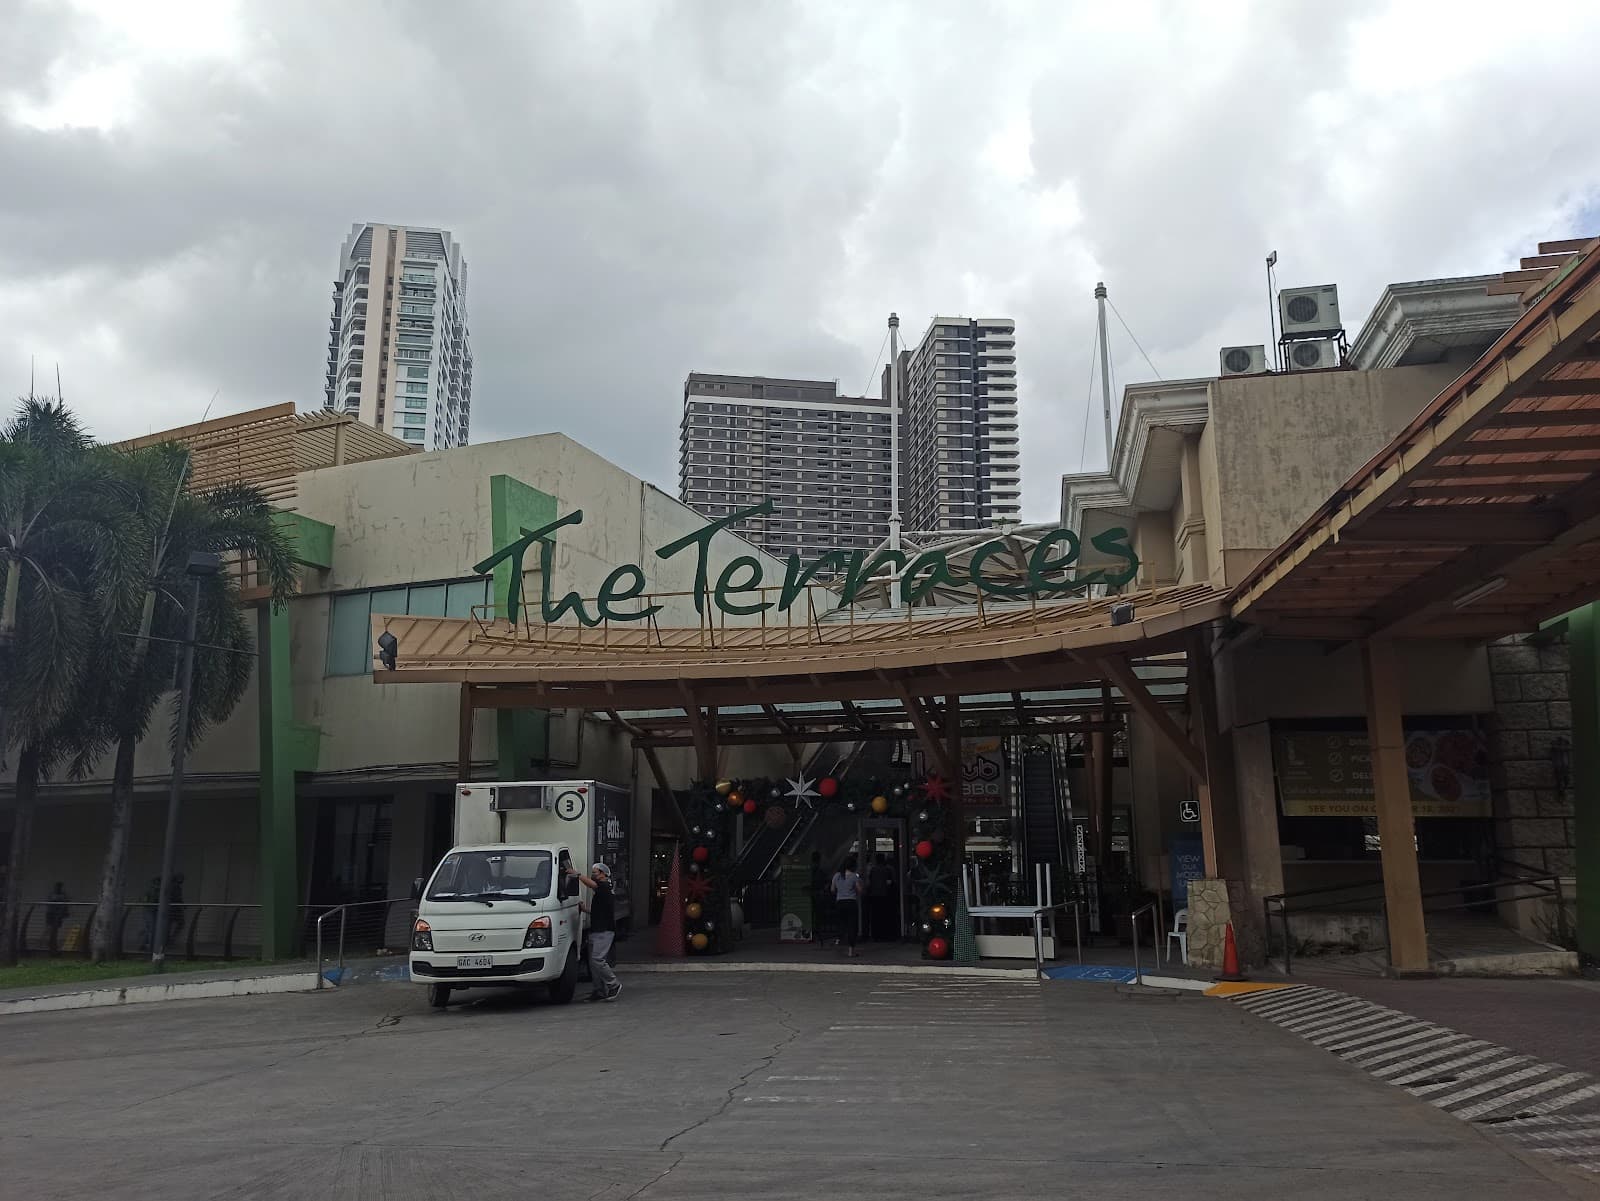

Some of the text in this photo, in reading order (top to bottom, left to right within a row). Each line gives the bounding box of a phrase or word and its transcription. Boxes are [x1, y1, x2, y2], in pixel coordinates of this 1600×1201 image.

[472, 500, 1140, 628] The Terraces
[566, 799, 574, 812] 3
[1308, 804, 1326, 813] SEE
[1328, 804, 1350, 813] YOU
[1351, 804, 1369, 813] ON
